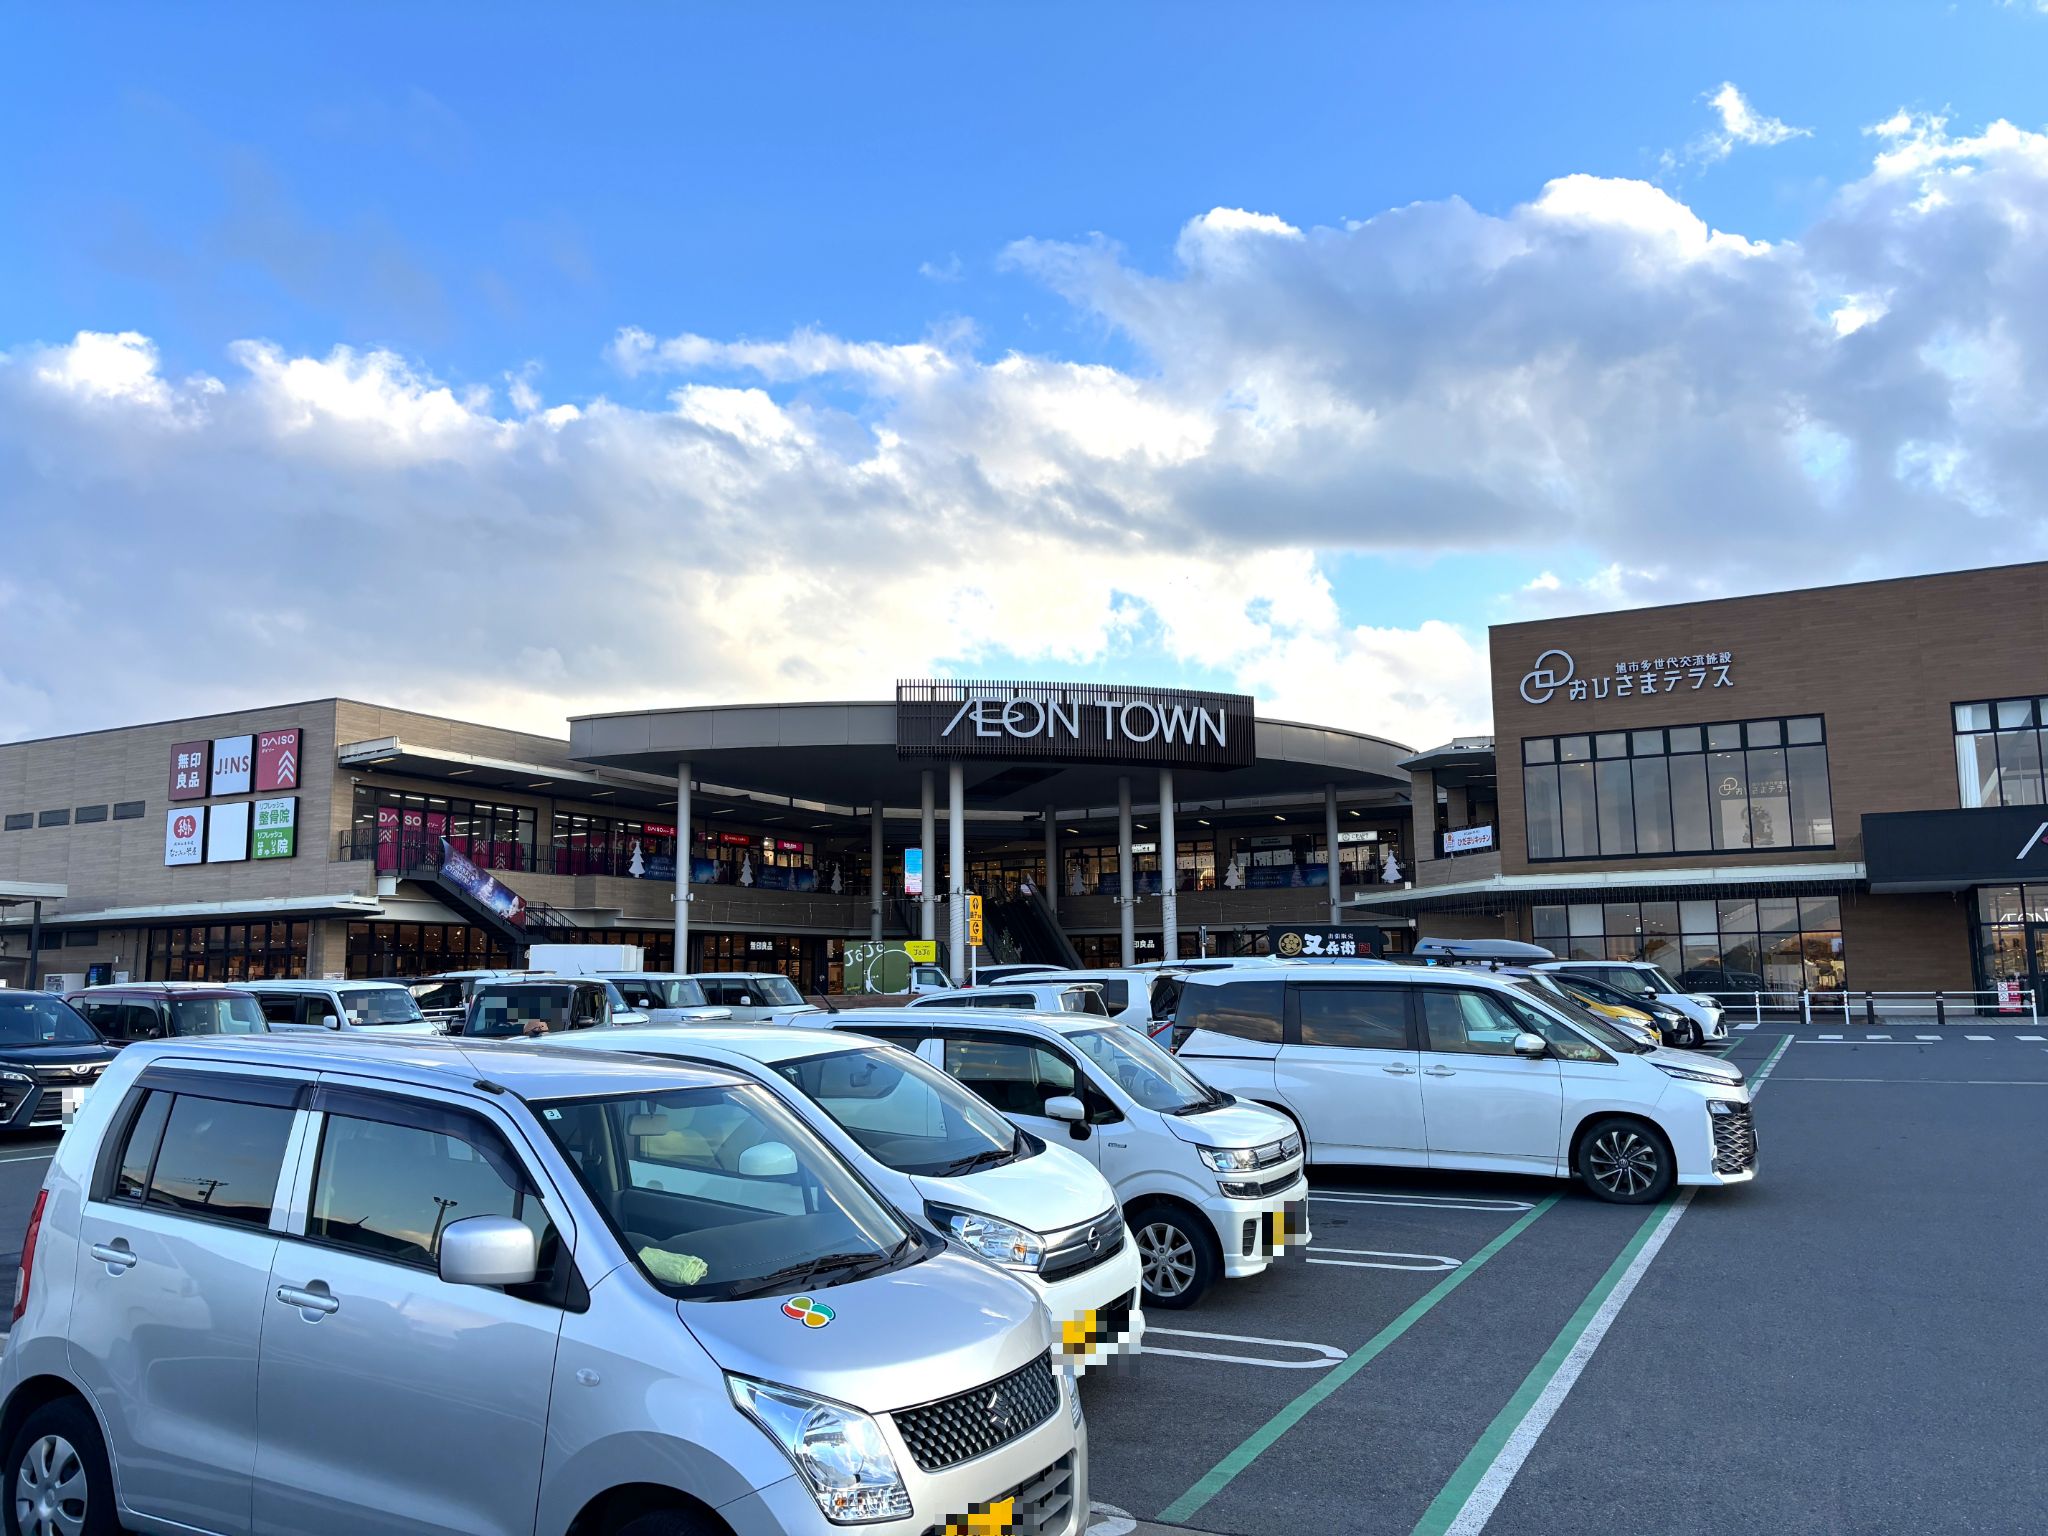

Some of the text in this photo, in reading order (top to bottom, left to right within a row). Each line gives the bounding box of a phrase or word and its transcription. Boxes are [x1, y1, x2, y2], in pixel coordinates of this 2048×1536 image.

[1615, 651, 1732, 674] 旭市多世代交流施設
[1568, 665, 1734, 701] おひさまテラス
[1095, 700, 1226, 748] TOWN
[261, 734, 295, 747] DAISO
[177, 752, 202, 770] 無印
[176, 771, 200, 790] 良品
[259, 808, 290, 826] 整骨院
[379, 811, 422, 828] DASO
[277, 838, 289, 854] 院
[750, 940, 773, 951] 無印良品
[1134, 939, 1155, 949] 印良品
